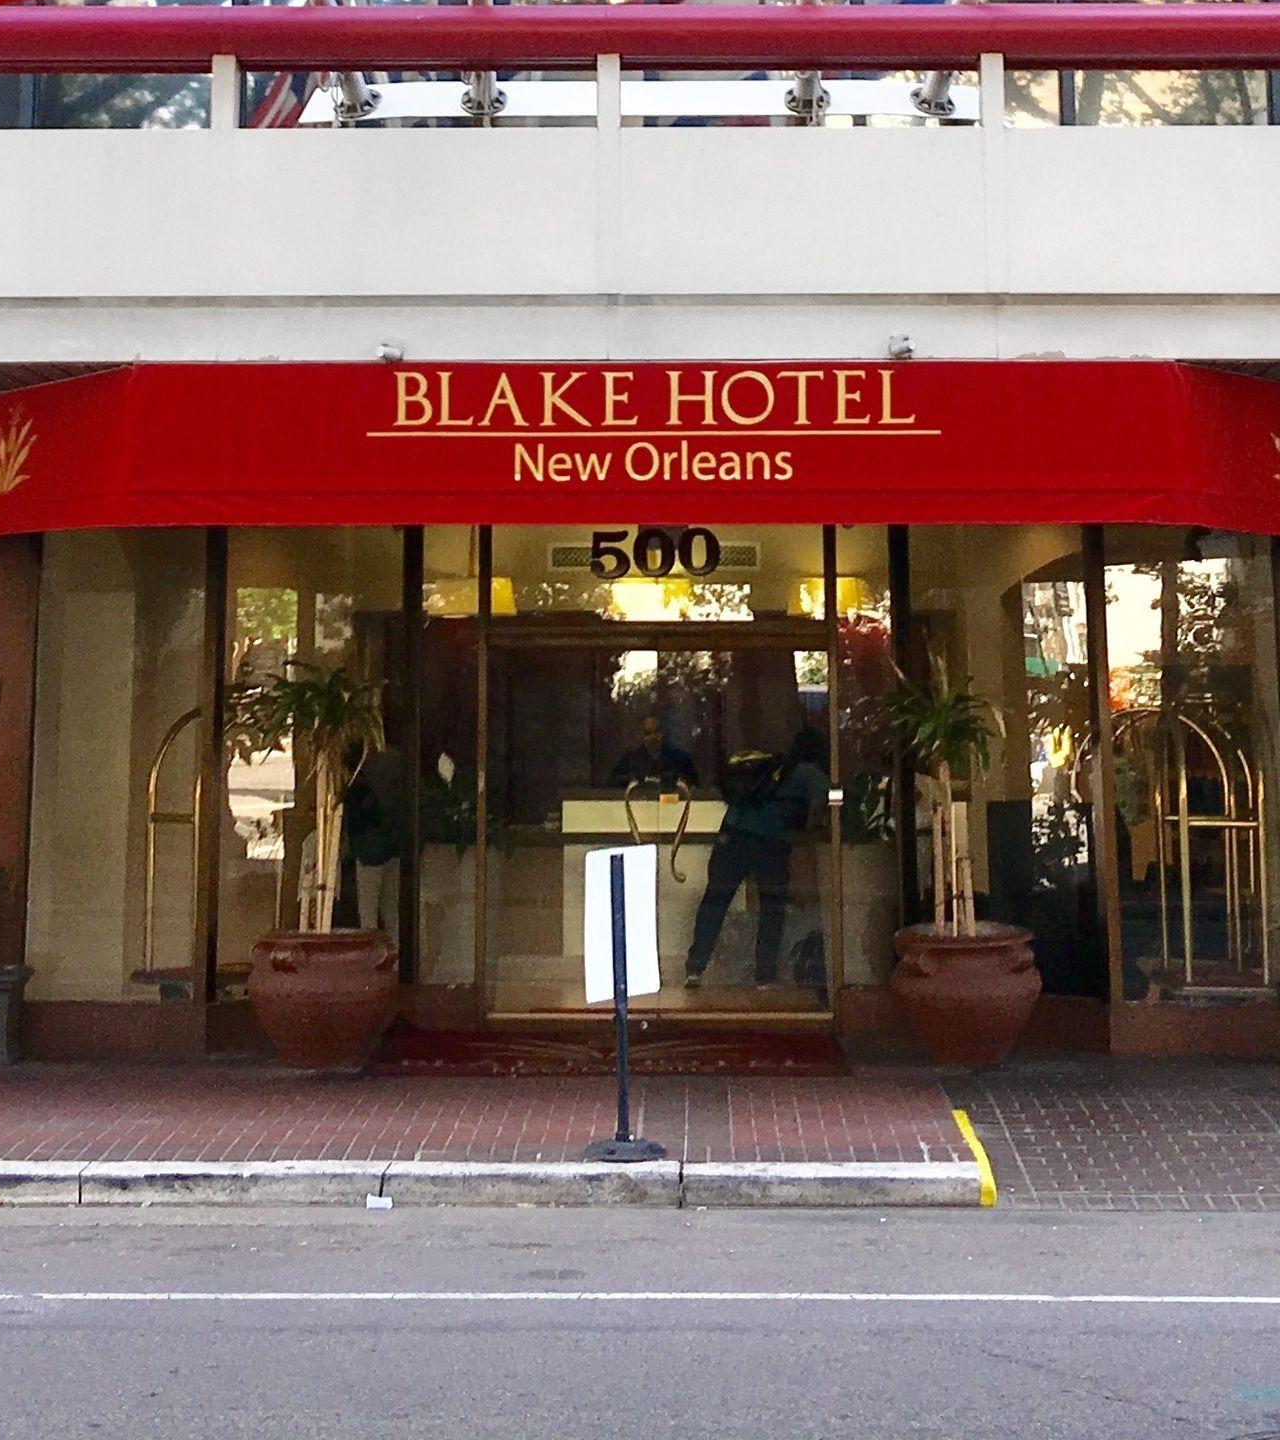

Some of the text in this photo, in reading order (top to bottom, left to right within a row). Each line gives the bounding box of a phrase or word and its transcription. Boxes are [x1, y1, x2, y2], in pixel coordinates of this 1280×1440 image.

[393, 369, 916, 427] BLAKE HOTEL
[513, 440, 793, 482] New Orleans
[590, 527, 720, 579] 500
